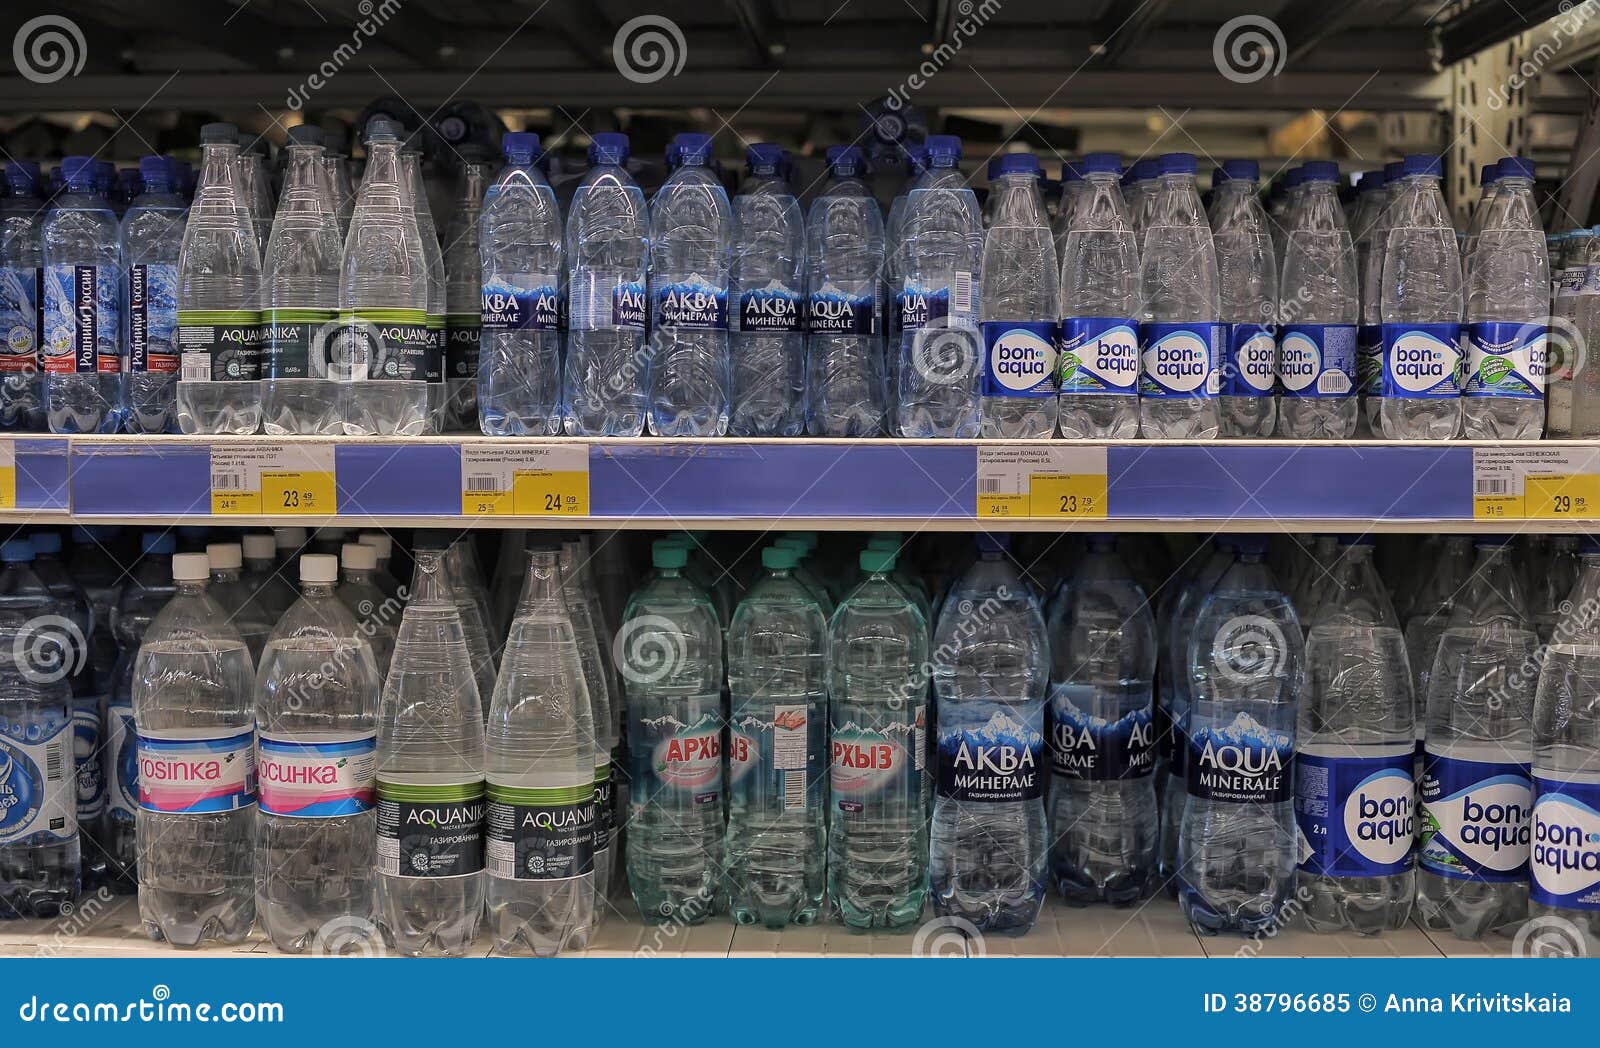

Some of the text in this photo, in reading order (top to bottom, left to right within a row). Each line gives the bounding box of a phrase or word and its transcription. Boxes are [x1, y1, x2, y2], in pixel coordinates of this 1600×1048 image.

[665, 289, 718, 312] АКВА
[745, 296, 796, 315] АКВА
[481, 313, 519, 322] ИНЕРАЛЕ
[665, 312, 718, 321] МИНЕРАЛЕ
[809, 300, 853, 320] AQUA
[746, 317, 796, 326] МИНЕРАЛЕ
[79, 313, 93, 367] Родники
[131, 313, 143, 366] Родники
[1097, 340, 1132, 357] bon
[999, 343, 1035, 361] bon
[1157, 344, 1193, 362] bon
[1396, 346, 1432, 362] bon
[998, 361, 1045, 378] aqua
[1096, 357, 1137, 375] aqua
[1156, 361, 1204, 379] aqua
[1396, 362, 1443, 379] aqua
[221, 500, 229, 508] 24
[283, 490, 299, 507] 23
[545, 494, 562, 511] 24
[1060, 495, 1092, 512] 23 79
[1554, 495, 1571, 512] 29
[991, 505, 1000, 513] 24
[831, 742, 893, 769] РХЫЗ
[953, 740, 1035, 775] АКВА
[1199, 739, 1282, 777] AQUA
[954, 774, 1034, 790] МИНЕРАЛЕ
[1200, 772, 1280, 791] MINERALE
[1359, 793, 1407, 819] bon
[1463, 796, 1521, 824] bon
[1313, 824, 1319, 834] 2
[1357, 816, 1414, 845] aqua
[1460, 824, 1530, 851] aqua
[1535, 814, 1583, 847] bon
[1534, 844, 1600, 875] aqua
